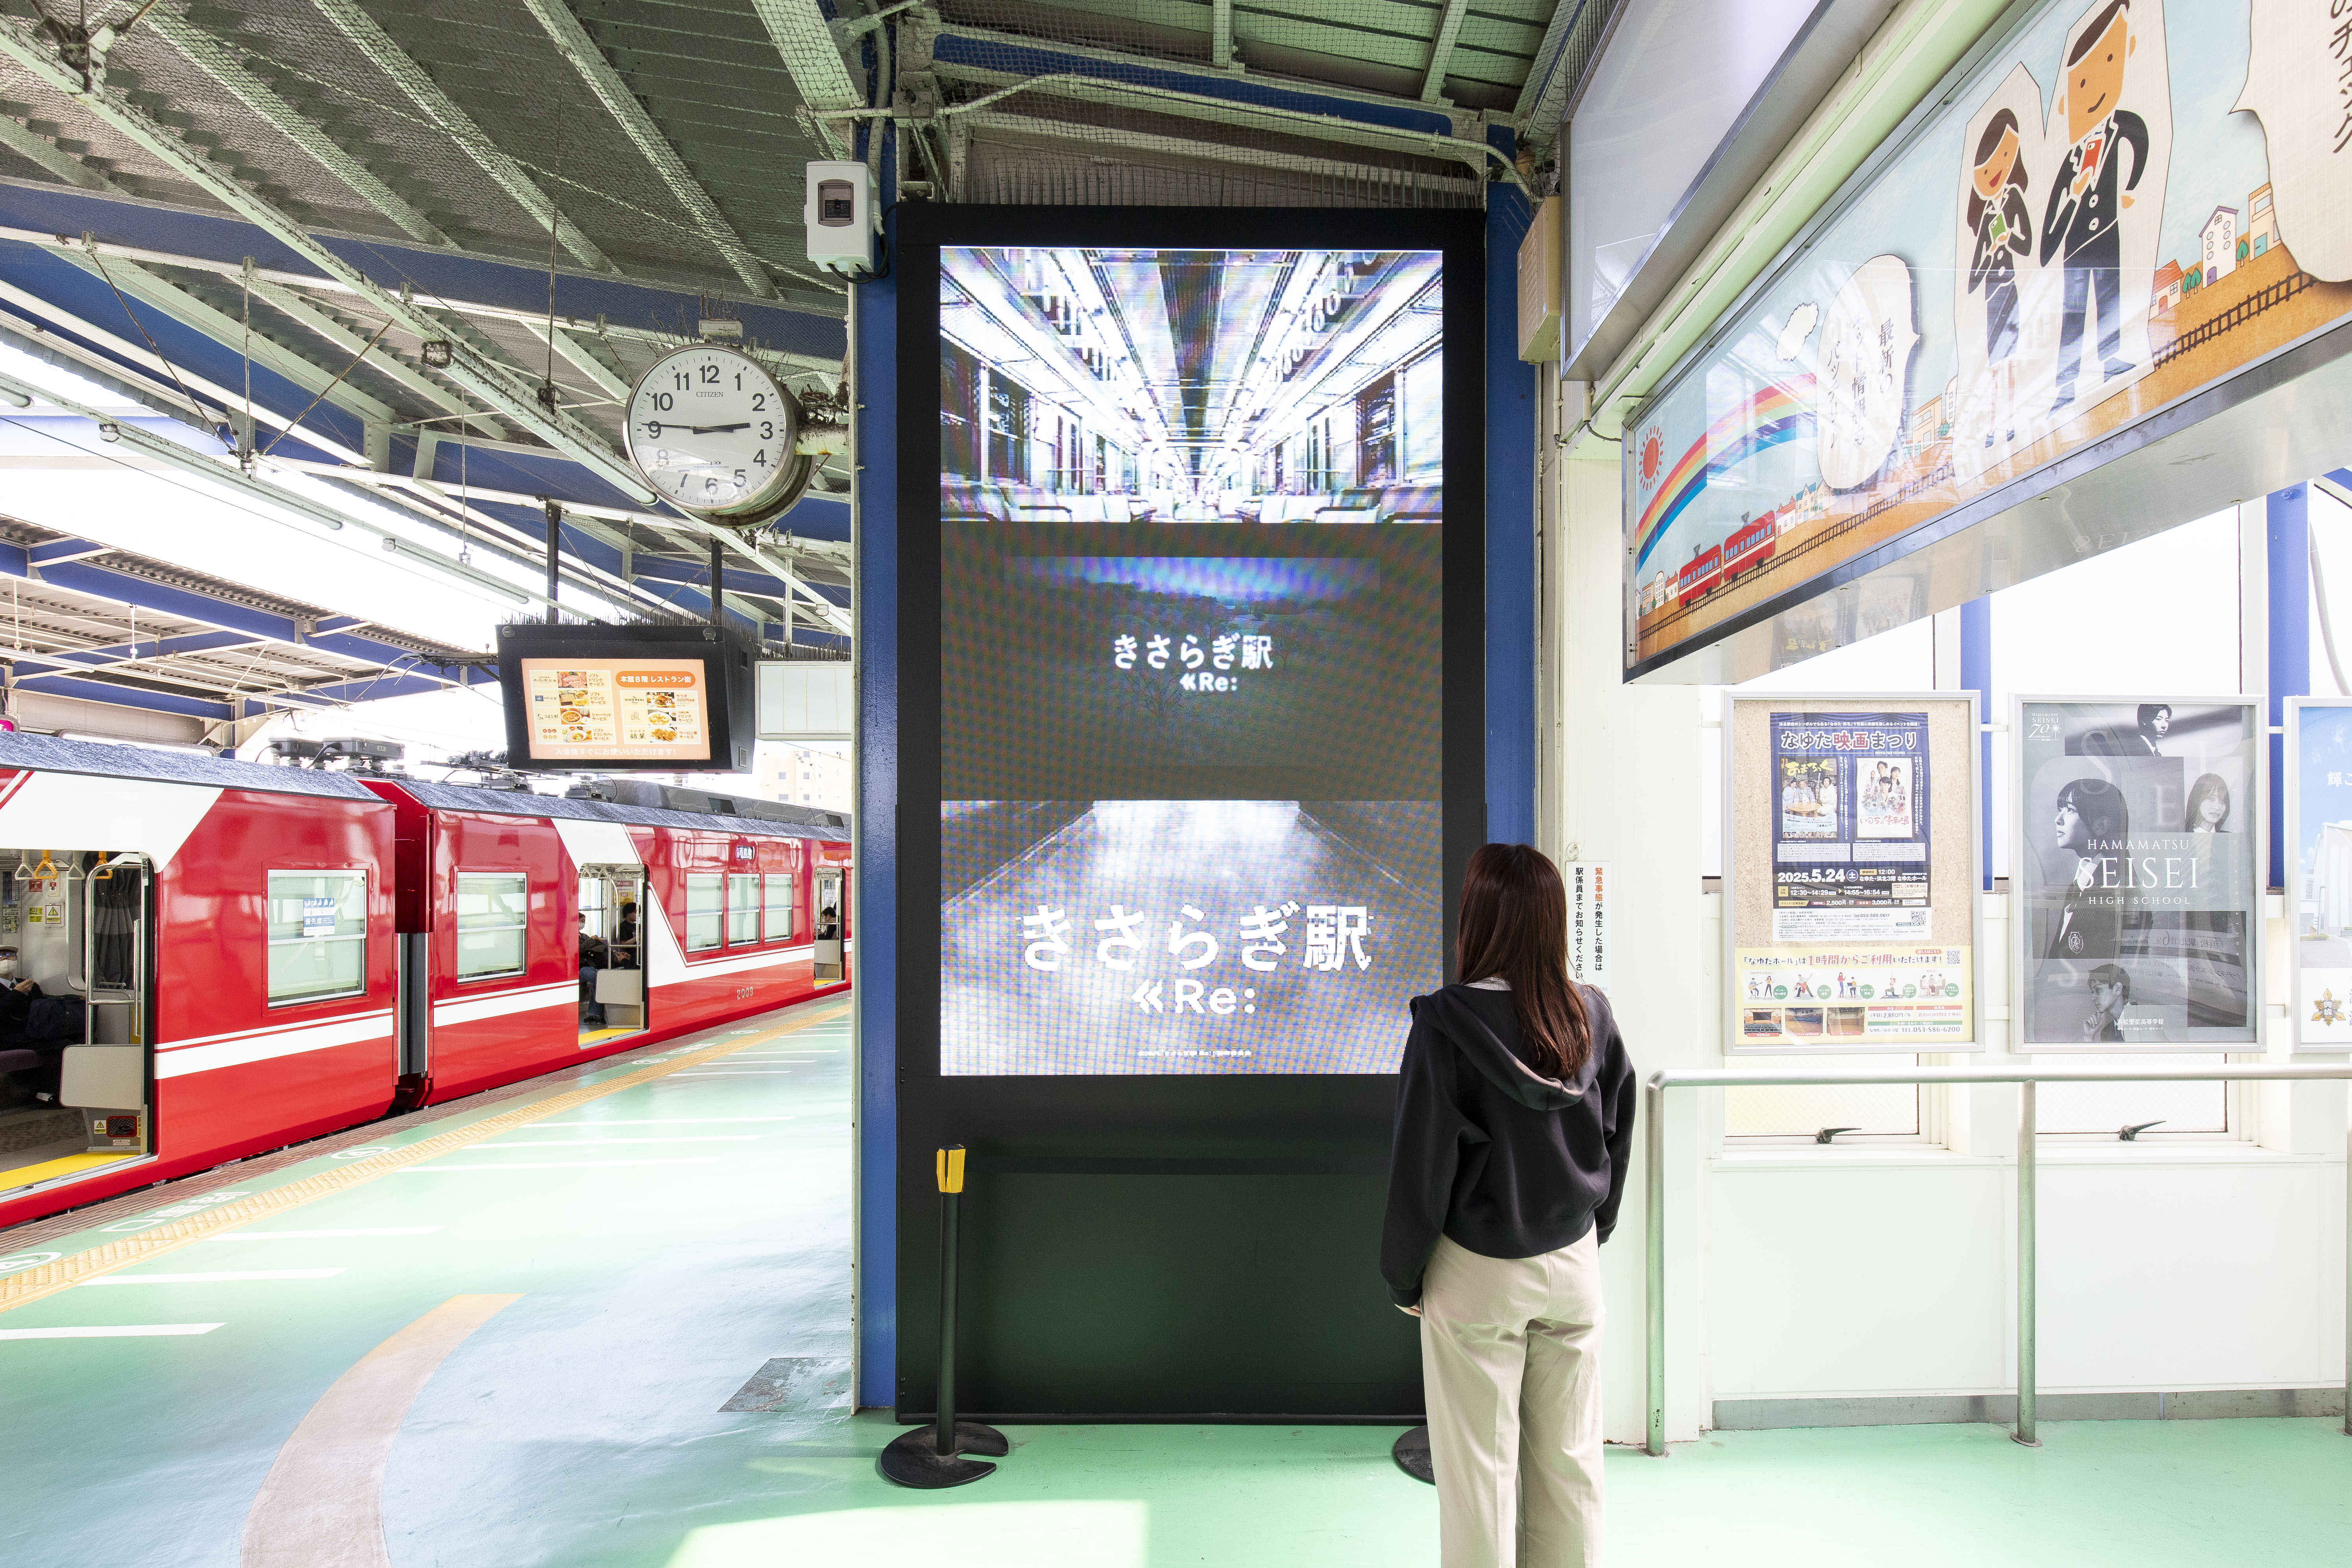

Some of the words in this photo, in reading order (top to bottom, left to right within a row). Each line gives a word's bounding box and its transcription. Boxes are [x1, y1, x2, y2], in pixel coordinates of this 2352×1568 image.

[1879, 318, 1894, 394] 最新の
[674, 373, 690, 390] 11
[699, 365, 719, 383] 12
[734, 373, 740, 391] 1
[652, 393, 673, 411] 10
[752, 393, 765, 411] 2
[648, 421, 661, 439] 9
[760, 421, 773, 439] 3
[657, 449, 670, 467] 8
[753, 449, 766, 467] 4
[678, 470, 690, 487] 7
[706, 478, 718, 496] 6
[734, 469, 746, 487] 5
[1114, 633, 1274, 670] きさらぎ駅
[1781, 730, 1917, 751] なゆた映画まつり
[556, 747, 676, 756] 入会後すぐにお使いいただけます!
[1785, 759, 1834, 776] あまろっく
[1860, 815, 1909, 825] いのちの停車場
[2088, 839, 2189, 850] HAMAMATSU
[1778, 869, 1845, 882] 2025.5.24
[2077, 857, 2199, 889] SEISEI
[1575, 867, 1584, 979] 駅係員までお知らせください
[1022, 901, 1374, 972] きさらぎ駅
[1744, 954, 1942, 965] 「なゆたホール」は1時間からご利用いただけます!
[737, 986, 753, 1000] 2009
